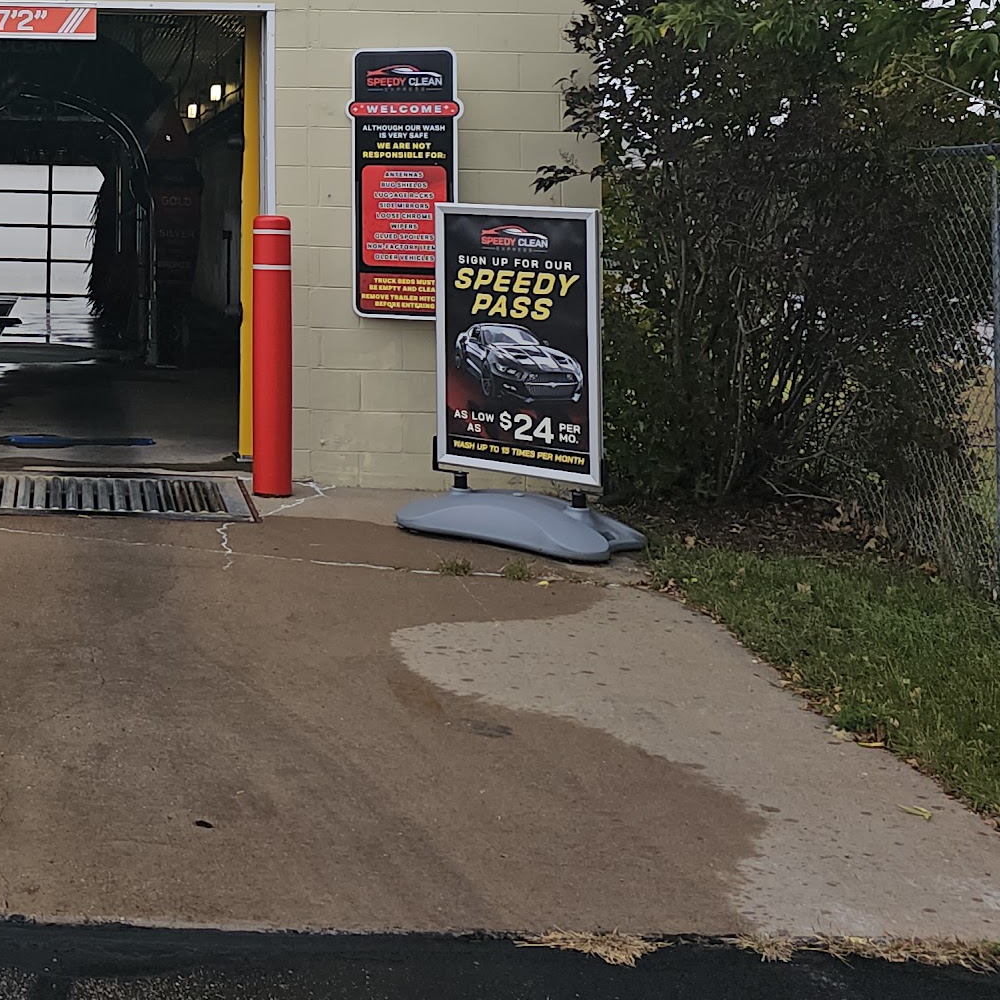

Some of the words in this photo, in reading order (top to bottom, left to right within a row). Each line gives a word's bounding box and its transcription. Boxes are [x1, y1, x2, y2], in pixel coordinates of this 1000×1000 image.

[366, 76, 407, 87] SPEEDY
[408, 76, 443, 87] CLEAN
[366, 104, 443, 114] WELCOME
[362, 124, 404, 132] ALTHOUGH
[404, 124, 422, 132] OUR
[422, 124, 446, 132] WASH
[376, 142, 391, 150] WE
[392, 142, 411, 150] ARE
[412, 142, 432, 150] NOT
[362, 151, 424, 159] RESPONSIBLE
[161, 195, 193, 207] GOLD
[159, 228, 195, 238] SILVER
[481, 236, 516, 246] SPEEDY
[517, 238, 549, 248] CLEAN
[458, 255, 487, 265] SIGN
[492, 257, 509, 267] UP
[514, 258, 539, 269] FOR
[544, 260, 572, 271] OUR
[454, 266, 581, 297] SPEEDY
[470, 292, 554, 321] PASS
[454, 409, 468, 419] AS
[471, 411, 495, 423] LOW
[499, 410, 555, 444] $24
[467, 422, 482, 432] AS
[558, 423, 581, 434] PER
[558, 434, 580, 444] MO.
[453, 439, 475, 450] WASH
[476, 442, 488, 451] UP
[489, 444, 499, 454] TO
[501, 446, 510, 455] 15
[511, 447, 535, 458] TIMES
[537, 451, 553, 461] PER
[554, 453, 585, 466] MONTH
